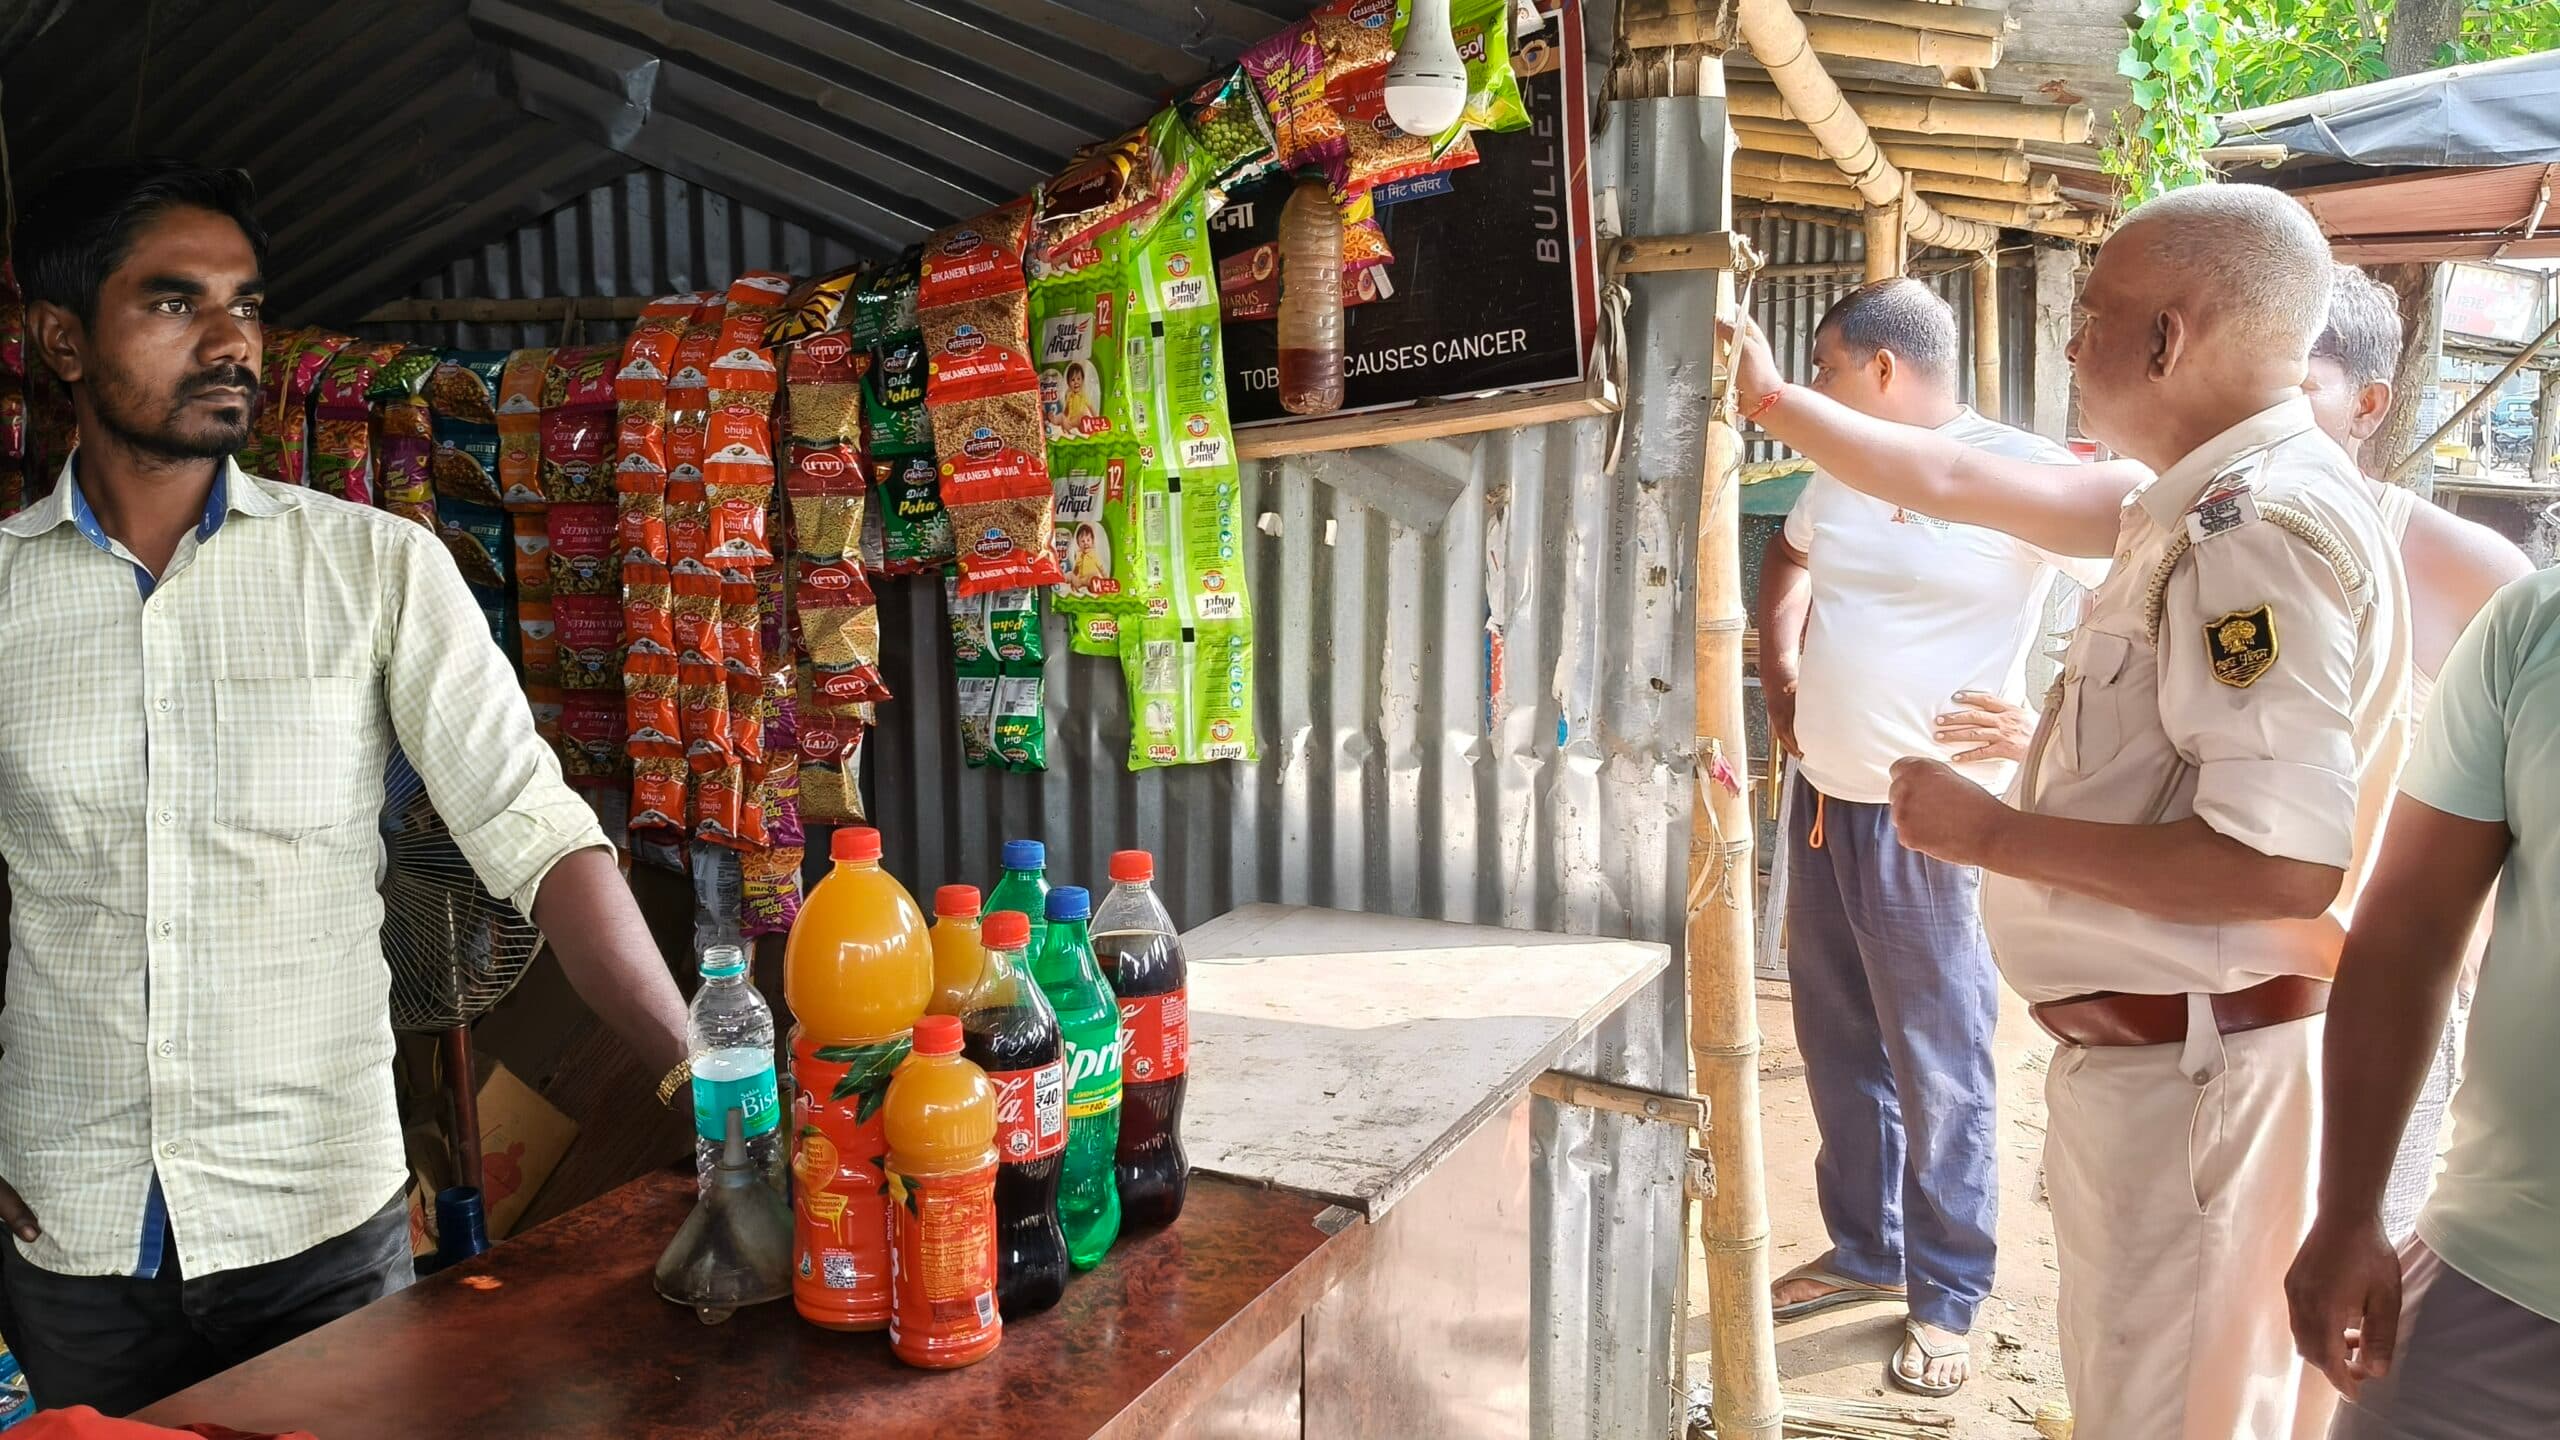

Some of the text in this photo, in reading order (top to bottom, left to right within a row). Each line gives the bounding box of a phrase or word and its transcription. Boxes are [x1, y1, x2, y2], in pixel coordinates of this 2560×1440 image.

[1454, 27, 1476, 38] TRA
[1461, 33, 1485, 61] GO!
[1529, 85, 1560, 263] BULLET
[1388, 183, 1408, 199] मिंट
[931, 260, 995, 283] BIKANERI BHUJIA
[1171, 281, 1202, 295] Angel
[1222, 290, 1259, 309] HARMS
[1097, 300, 1110, 325] 12
[1232, 303, 1269, 317] BULLET
[1047, 334, 1083, 357] Angel
[1343, 328, 1527, 378] CAUSES CANCER
[939, 362, 1005, 382] BIKANERI BHUJIA
[724, 424, 753, 439] bhujia
[1190, 442, 1220, 456] Angel
[805, 460, 840, 472] LALJI
[954, 465, 1020, 484] BIKANERI BHUJIA
[1108, 464, 1122, 489] 12
[906, 487, 929, 499] Diet
[898, 499, 937, 516] Poha
[1057, 496, 1093, 516] Angel
[811, 574, 849, 585] LALJI
[968, 568, 1003, 581] BIKANERI
[1149, 598, 1168, 610] Pan
[1203, 595, 1236, 608] Angel
[1088, 619, 1119, 633] Pants
[828, 678, 865, 691] LALJI
[1149, 743, 1178, 757] Pants
[1211, 744, 1242, 760] Angel
[1065, 1040, 1122, 1090] Spri
